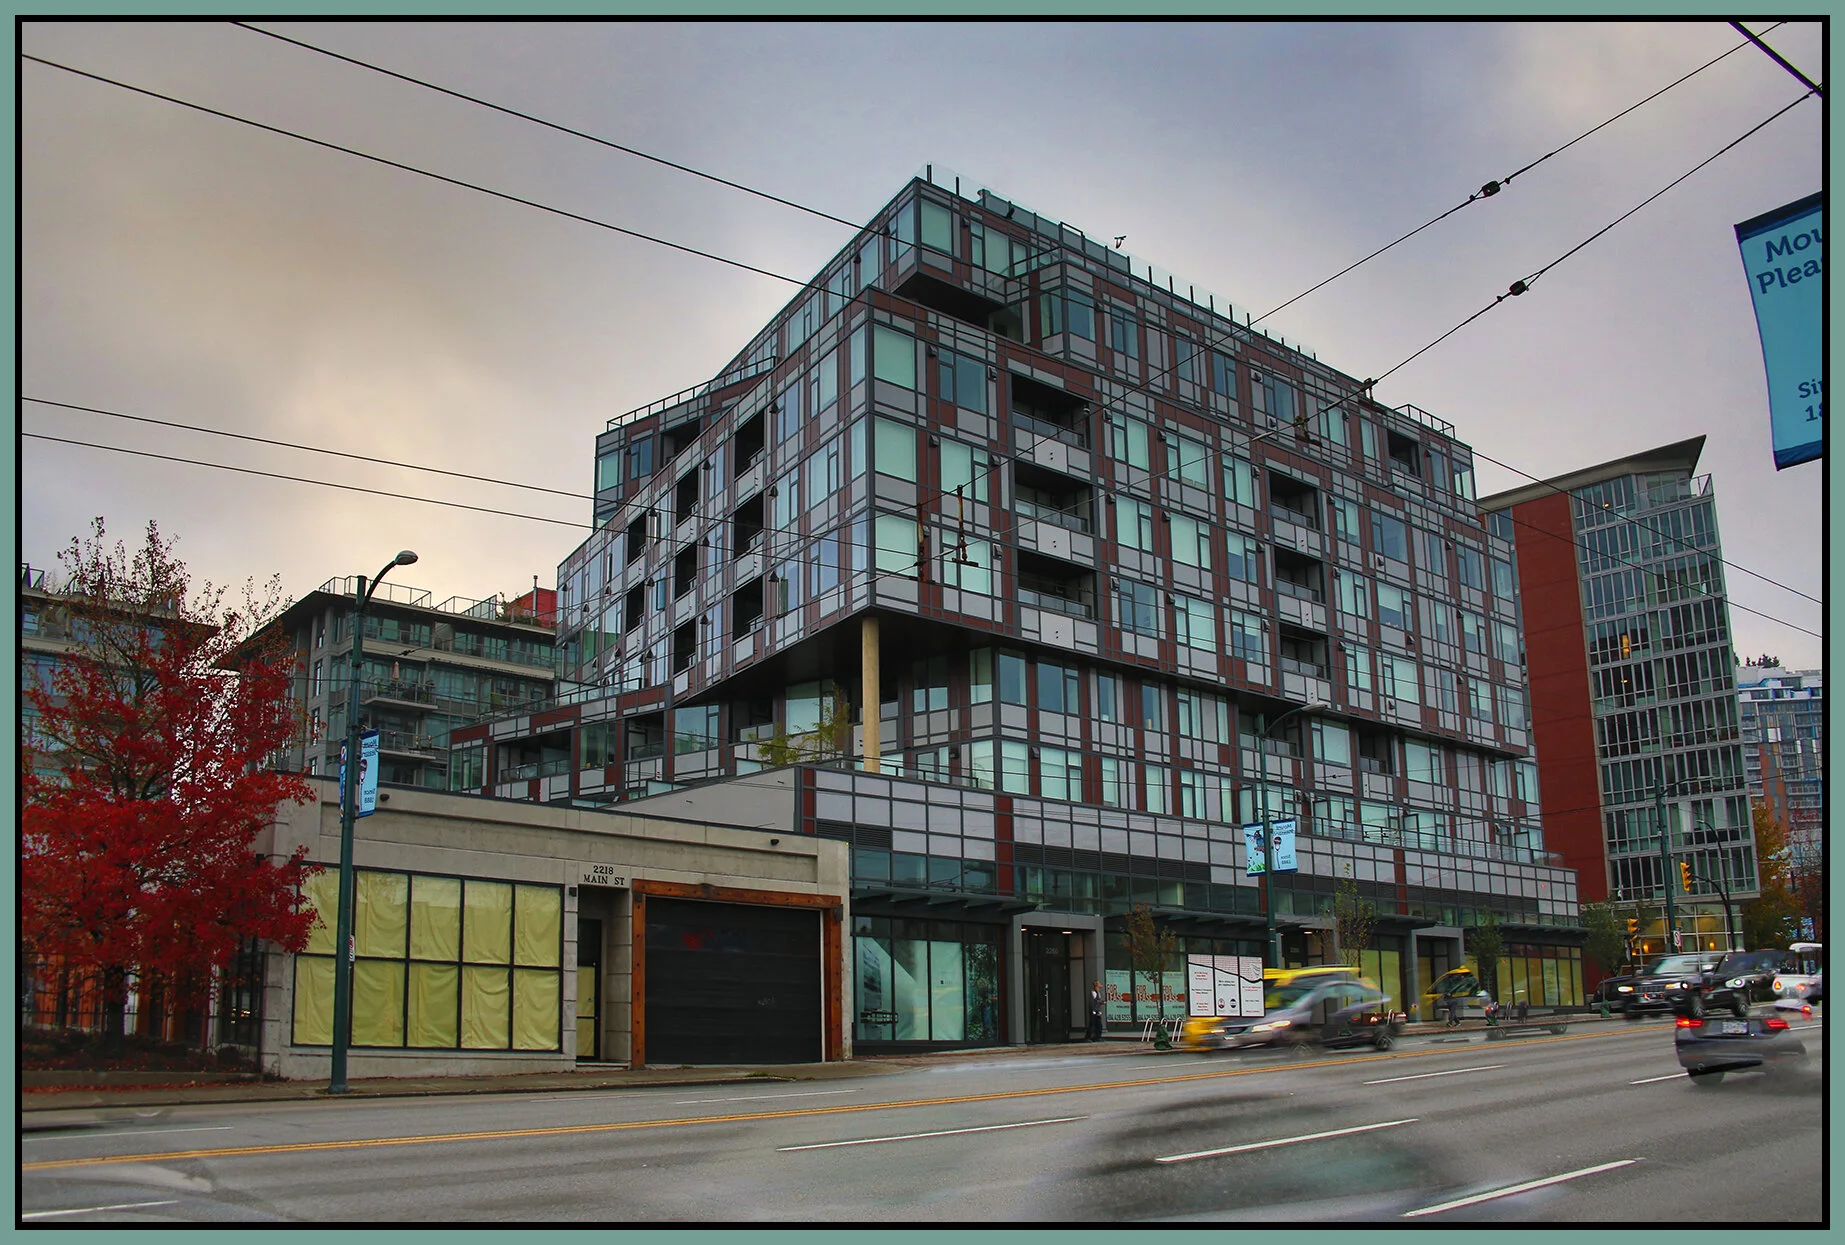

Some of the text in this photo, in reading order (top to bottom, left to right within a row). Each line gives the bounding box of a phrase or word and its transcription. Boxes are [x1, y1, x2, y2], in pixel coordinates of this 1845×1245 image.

[1756, 256, 1822, 294] Plea
[593, 865, 614, 875] 2218
[583, 874, 625, 886] MAIN ST
[1106, 984, 1117, 993] FOR
[1136, 985, 1147, 994] FOR
[1163, 985, 1172, 994] FOR
